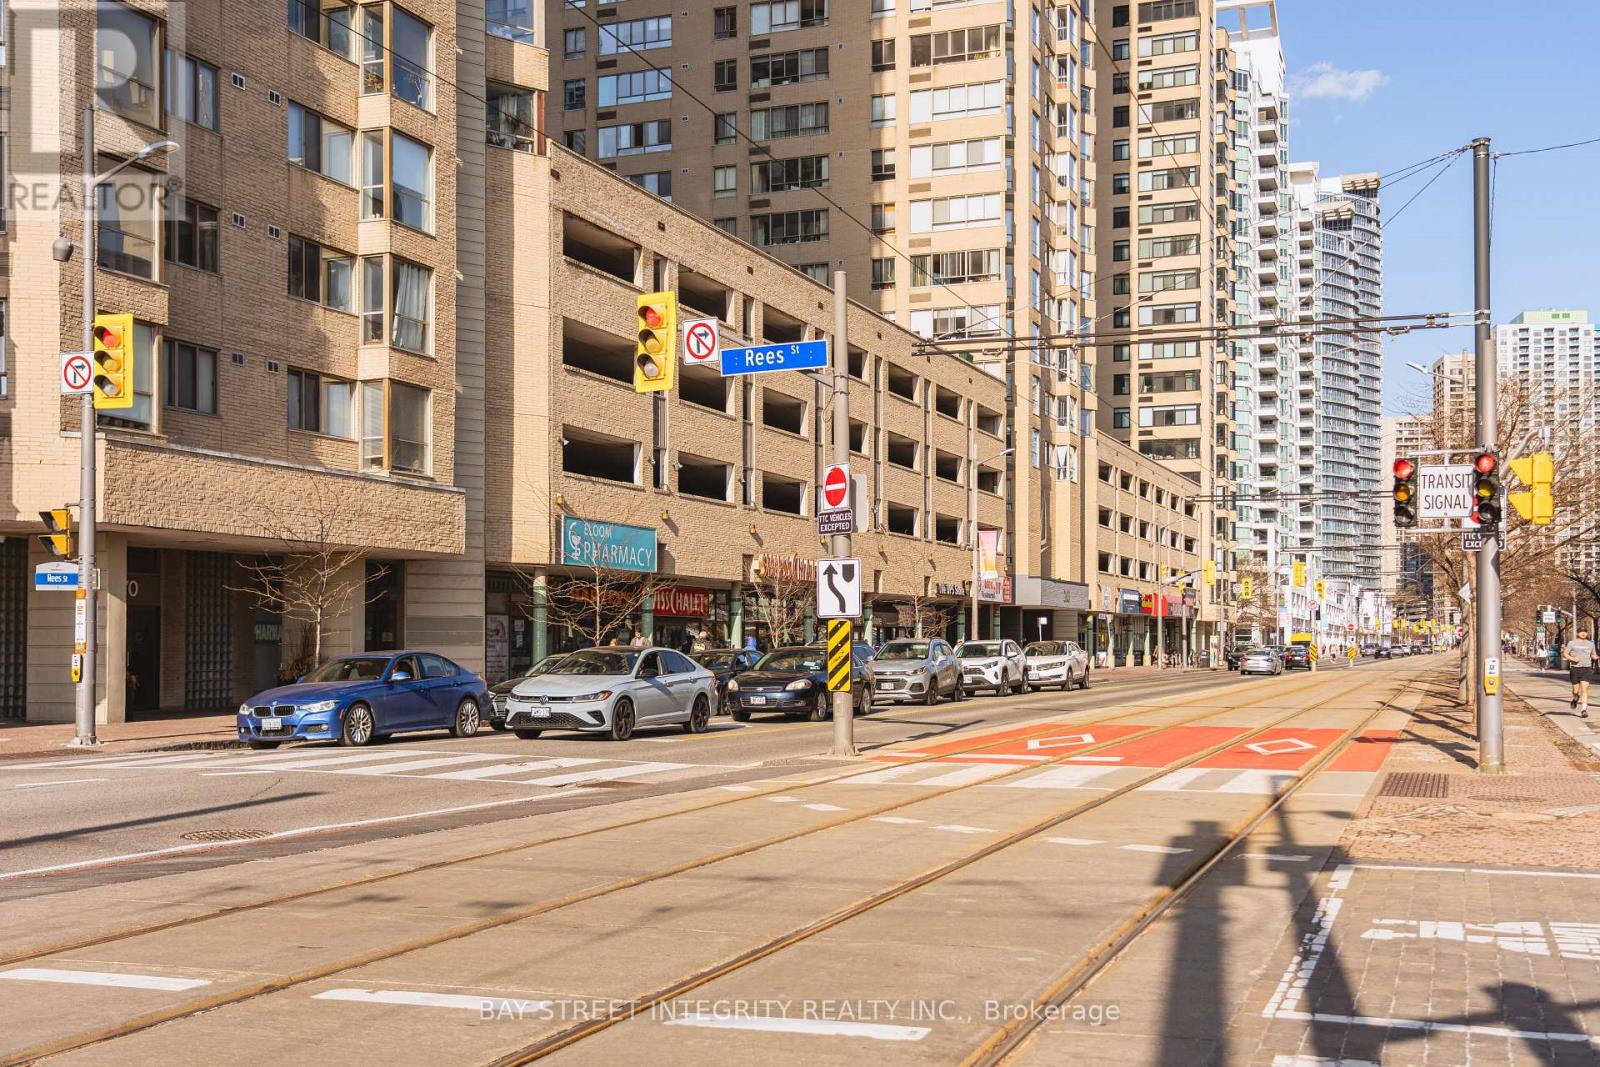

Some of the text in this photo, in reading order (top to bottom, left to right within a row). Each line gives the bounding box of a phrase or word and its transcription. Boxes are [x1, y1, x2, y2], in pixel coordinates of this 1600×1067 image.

[745, 345, 800, 367] Rees St
[1421, 473, 1473, 489] TRANSIT
[1424, 494, 1468, 510] SIGNAL
[819, 512, 852, 523] TTC VEHICLES
[820, 523, 850, 532] EXCEPTED
[584, 541, 652, 567] PHARMACY
[47, 574, 61, 583] Rees
